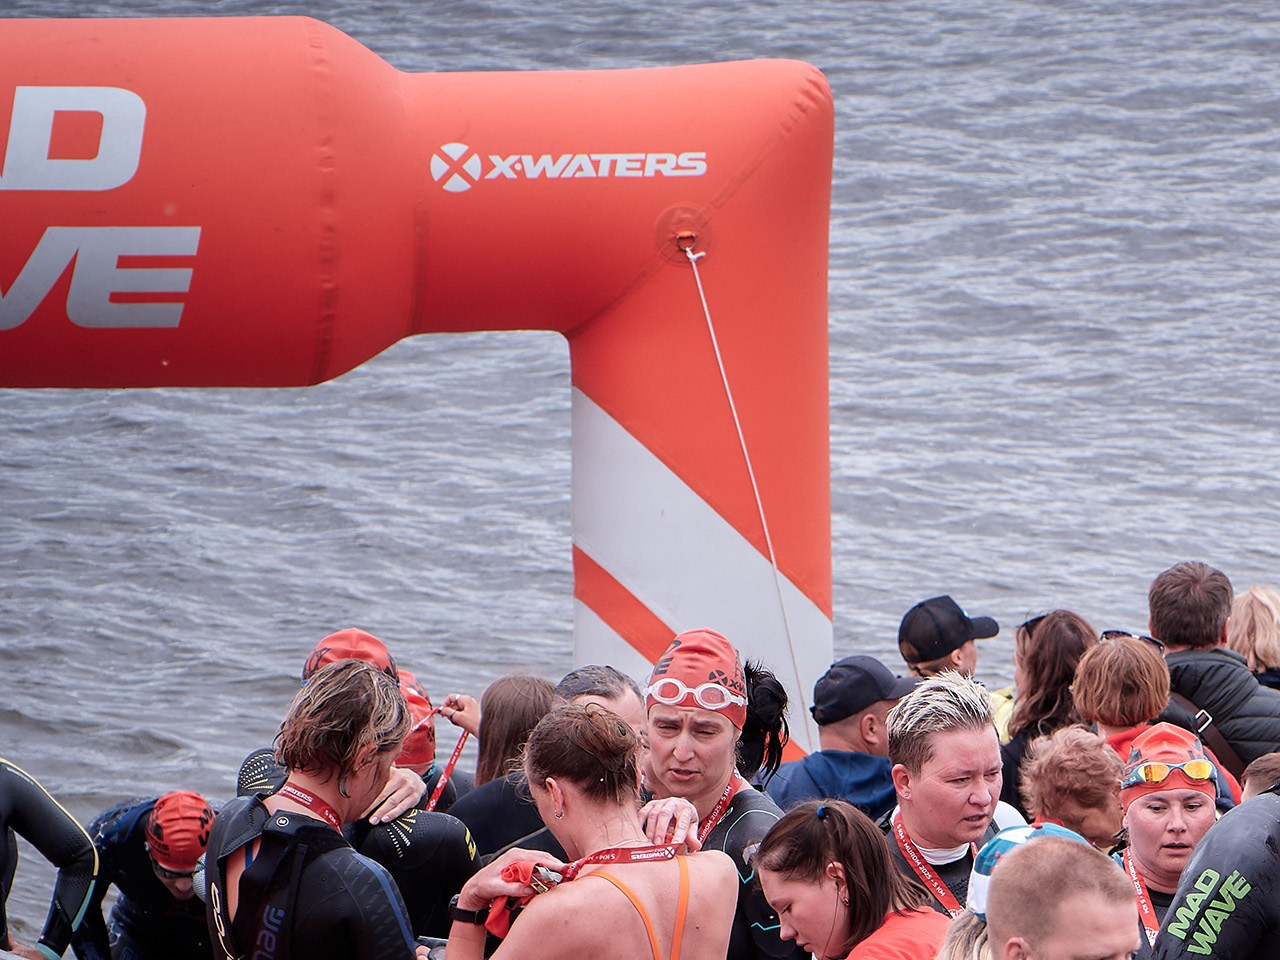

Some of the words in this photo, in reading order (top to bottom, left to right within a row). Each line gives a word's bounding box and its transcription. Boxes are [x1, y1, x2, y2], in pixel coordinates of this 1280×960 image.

[904, 842, 921, 866] MUROM
[918, 865, 931, 880] 2025
[1167, 868, 1221, 940] MAD
[1187, 869, 1252, 956] WAVE
